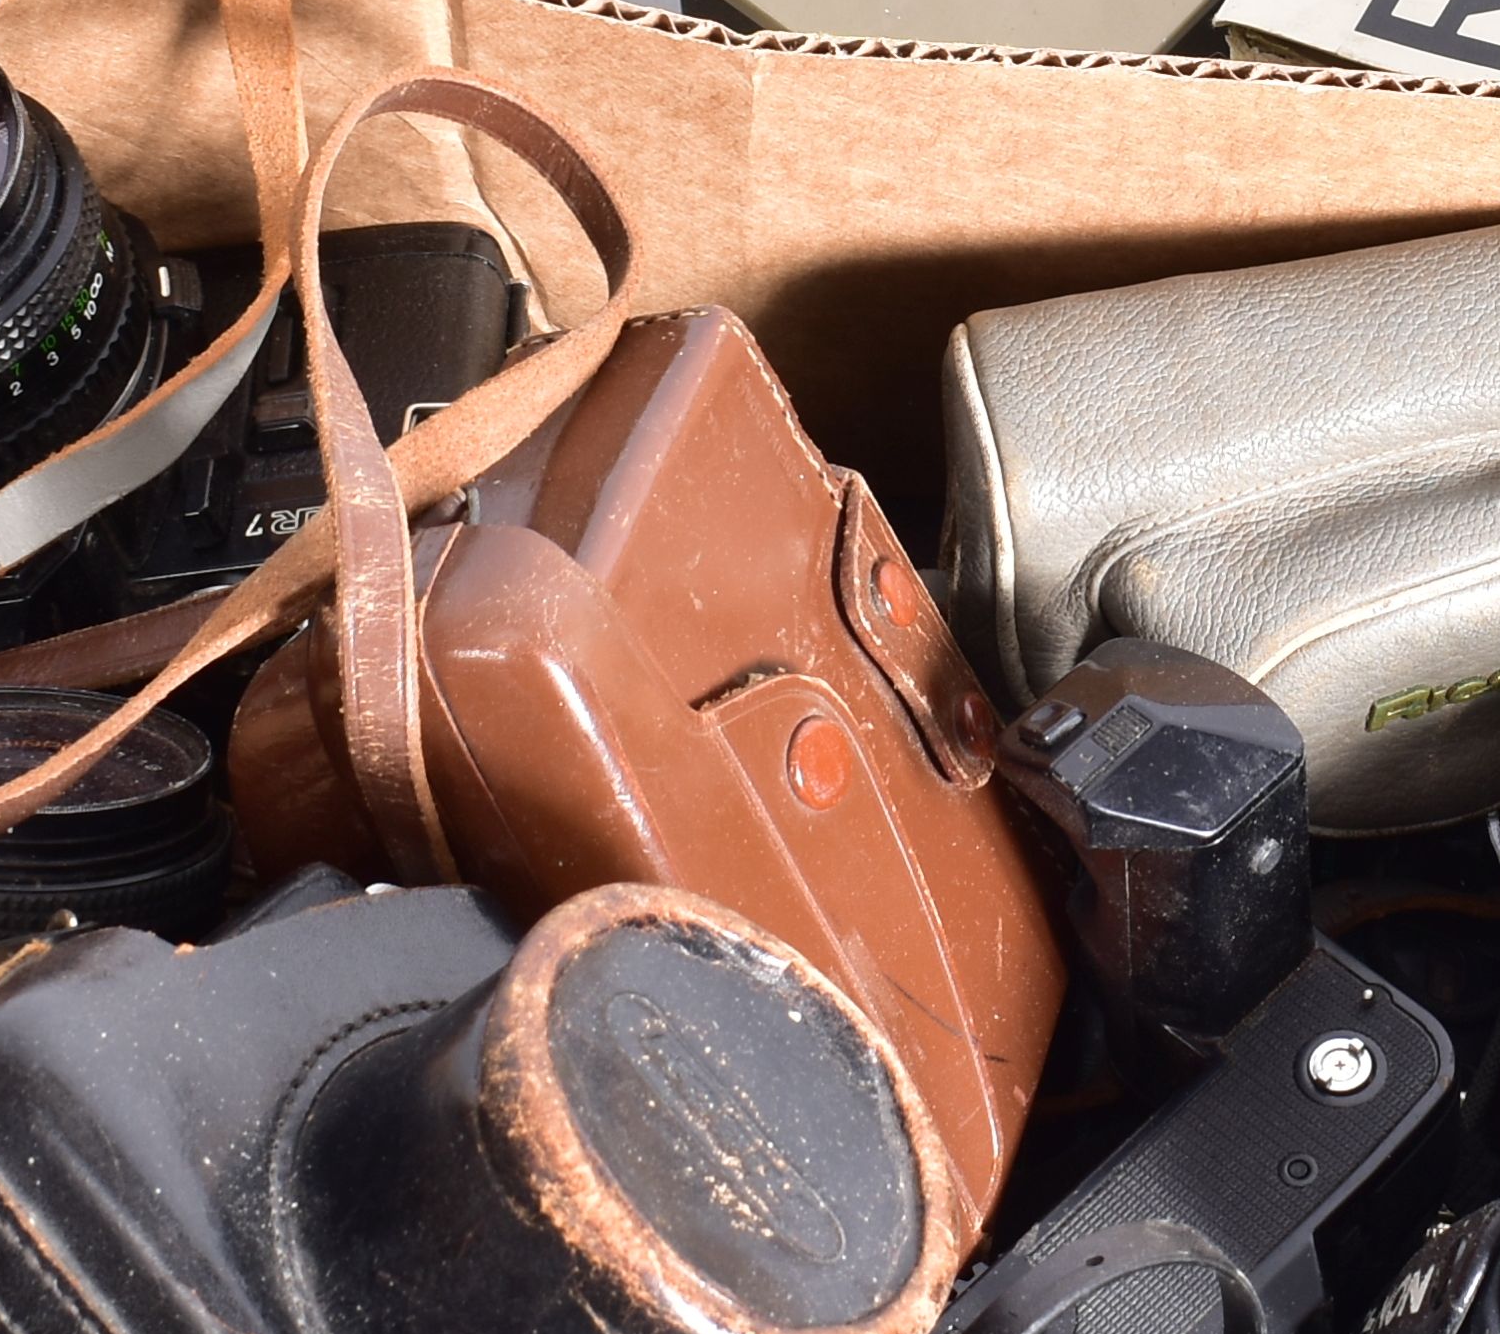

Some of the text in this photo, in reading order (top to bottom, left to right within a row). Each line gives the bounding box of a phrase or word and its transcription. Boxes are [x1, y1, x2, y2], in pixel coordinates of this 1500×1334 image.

[9, 381, 24, 398] 2
[46, 350, 60, 367] 3
[70, 324, 83, 341] 5
[83, 301, 98, 322] 10
[11, 362, 24, 376] 7
[39, 334, 58, 354] 10
[59, 314, 76, 333] 15
[73, 287, 91, 309] 30
